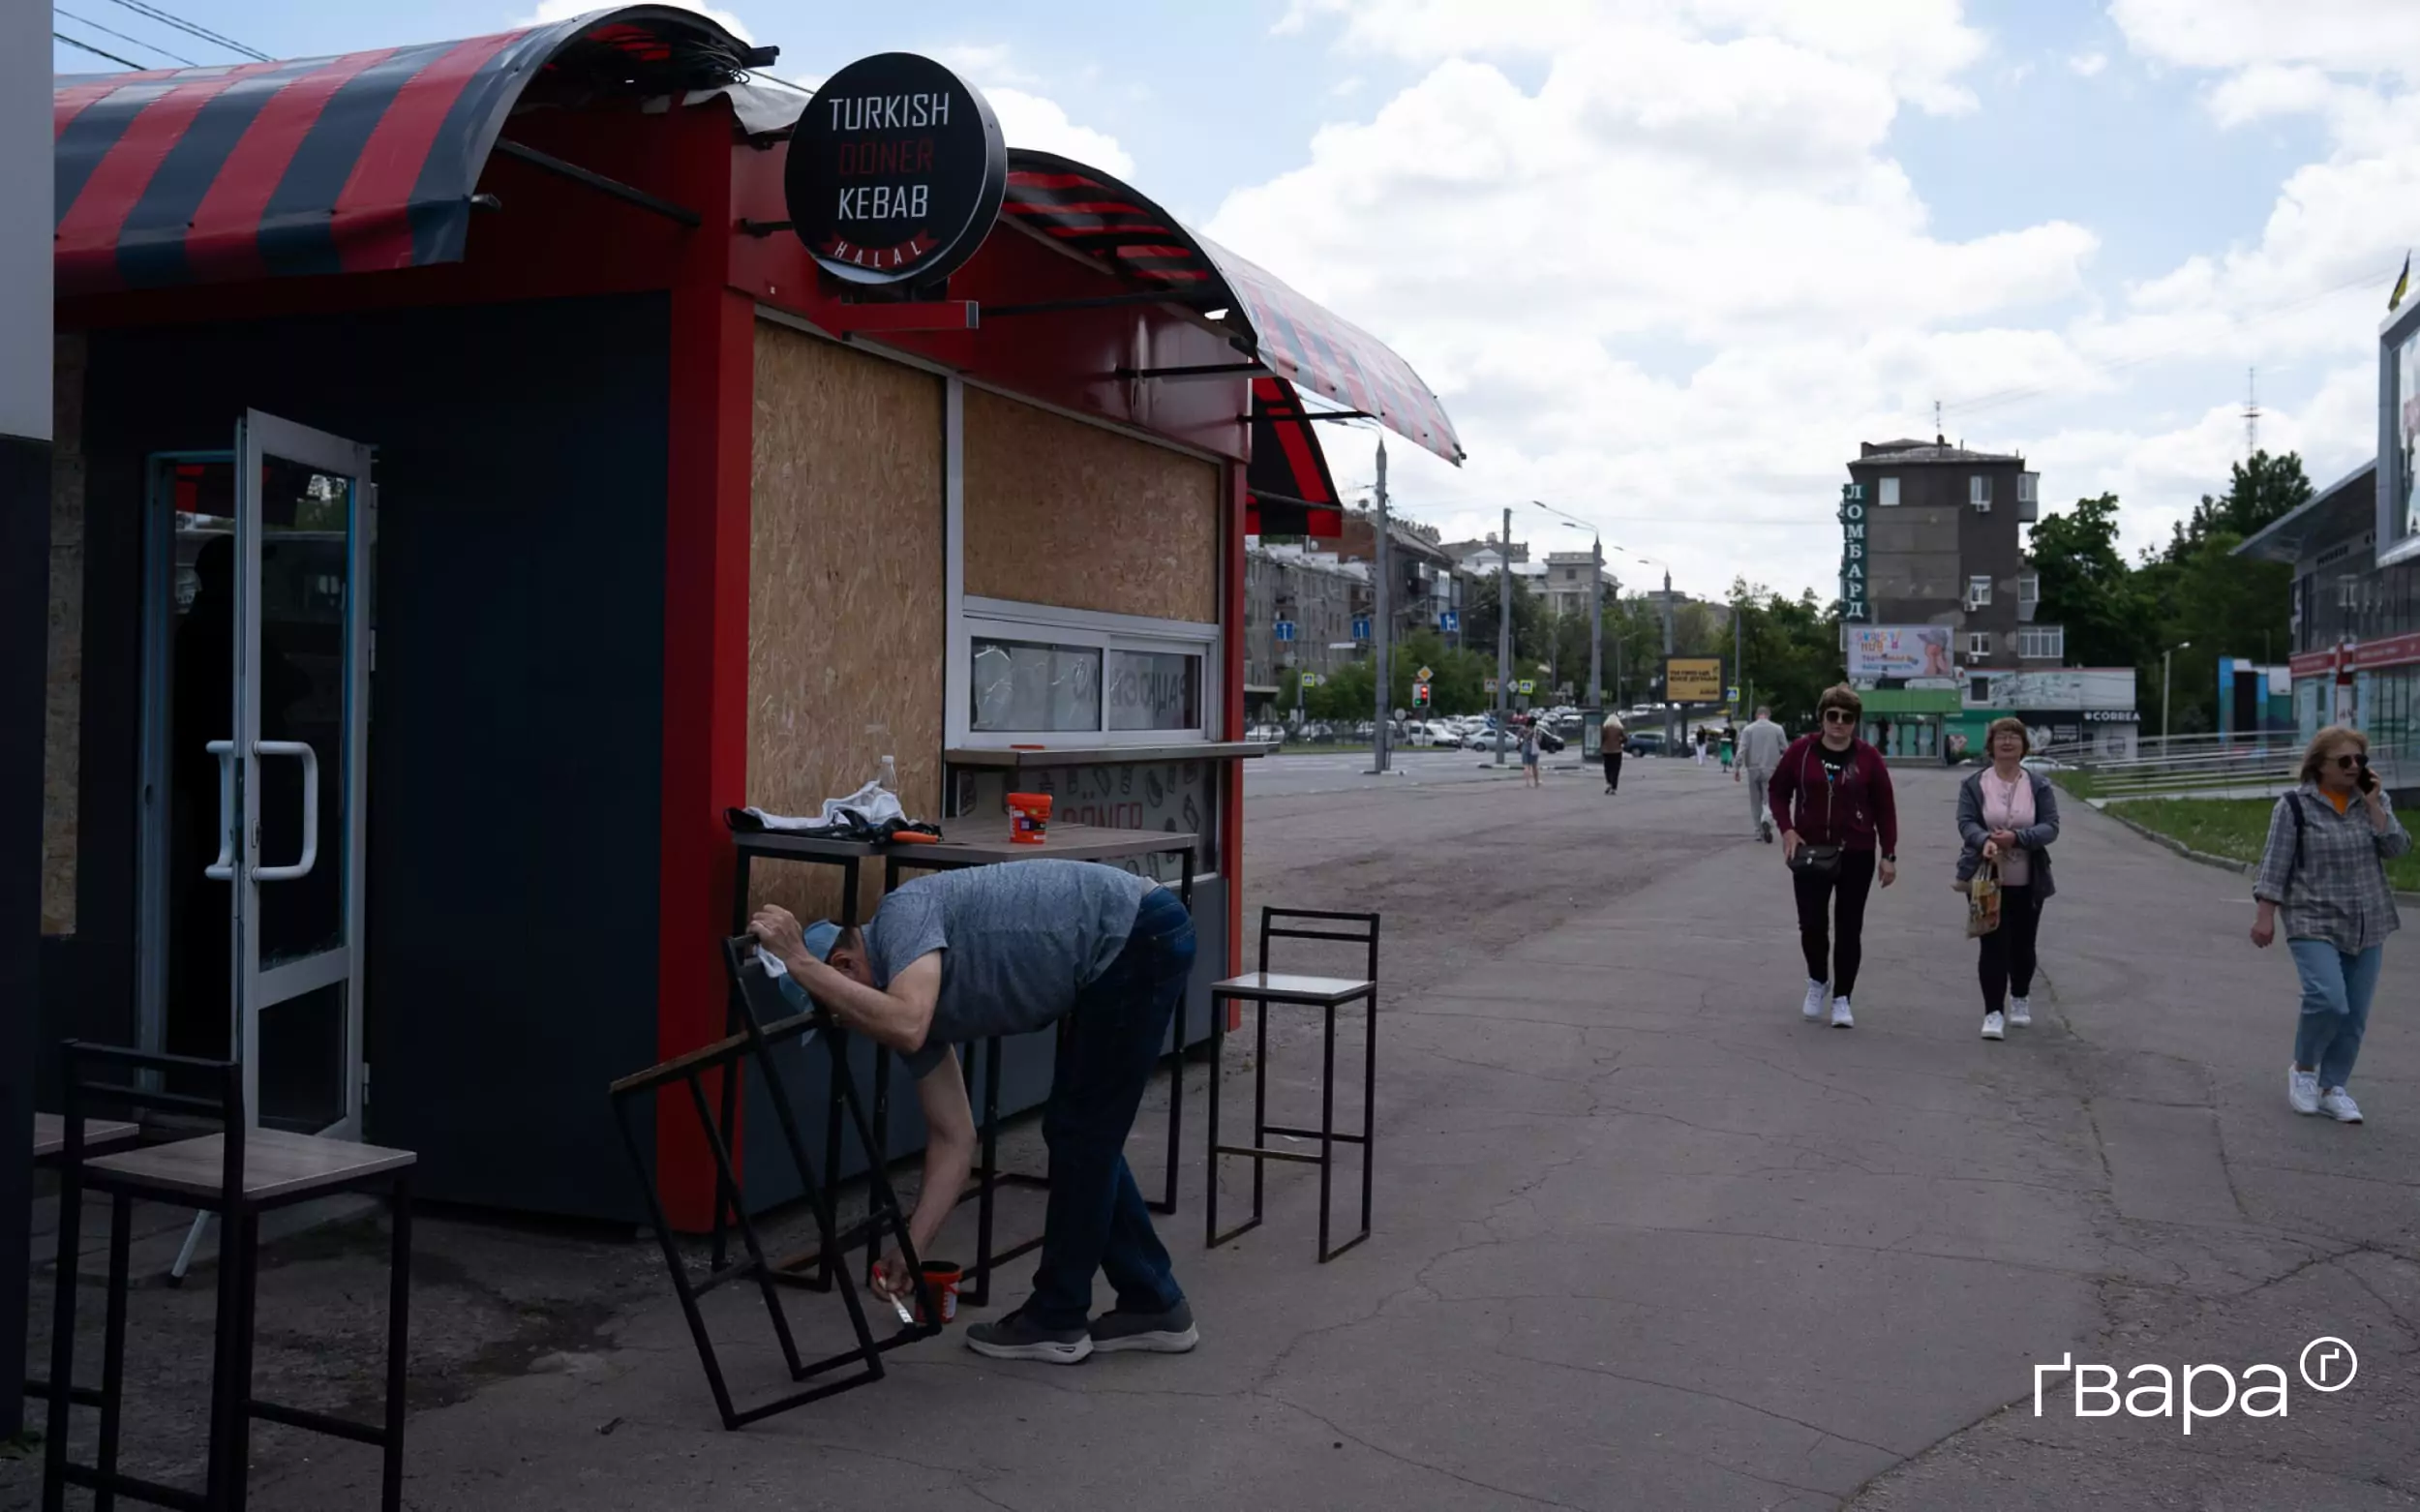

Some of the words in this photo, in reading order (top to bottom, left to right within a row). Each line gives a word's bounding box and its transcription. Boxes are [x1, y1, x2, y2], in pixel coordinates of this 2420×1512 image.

[829, 92, 950, 131] TURKISH
[838, 184, 929, 221] KEBAB
[834, 240, 923, 268] HALAL
[1846, 484, 1864, 619] ЛОМБАРД
